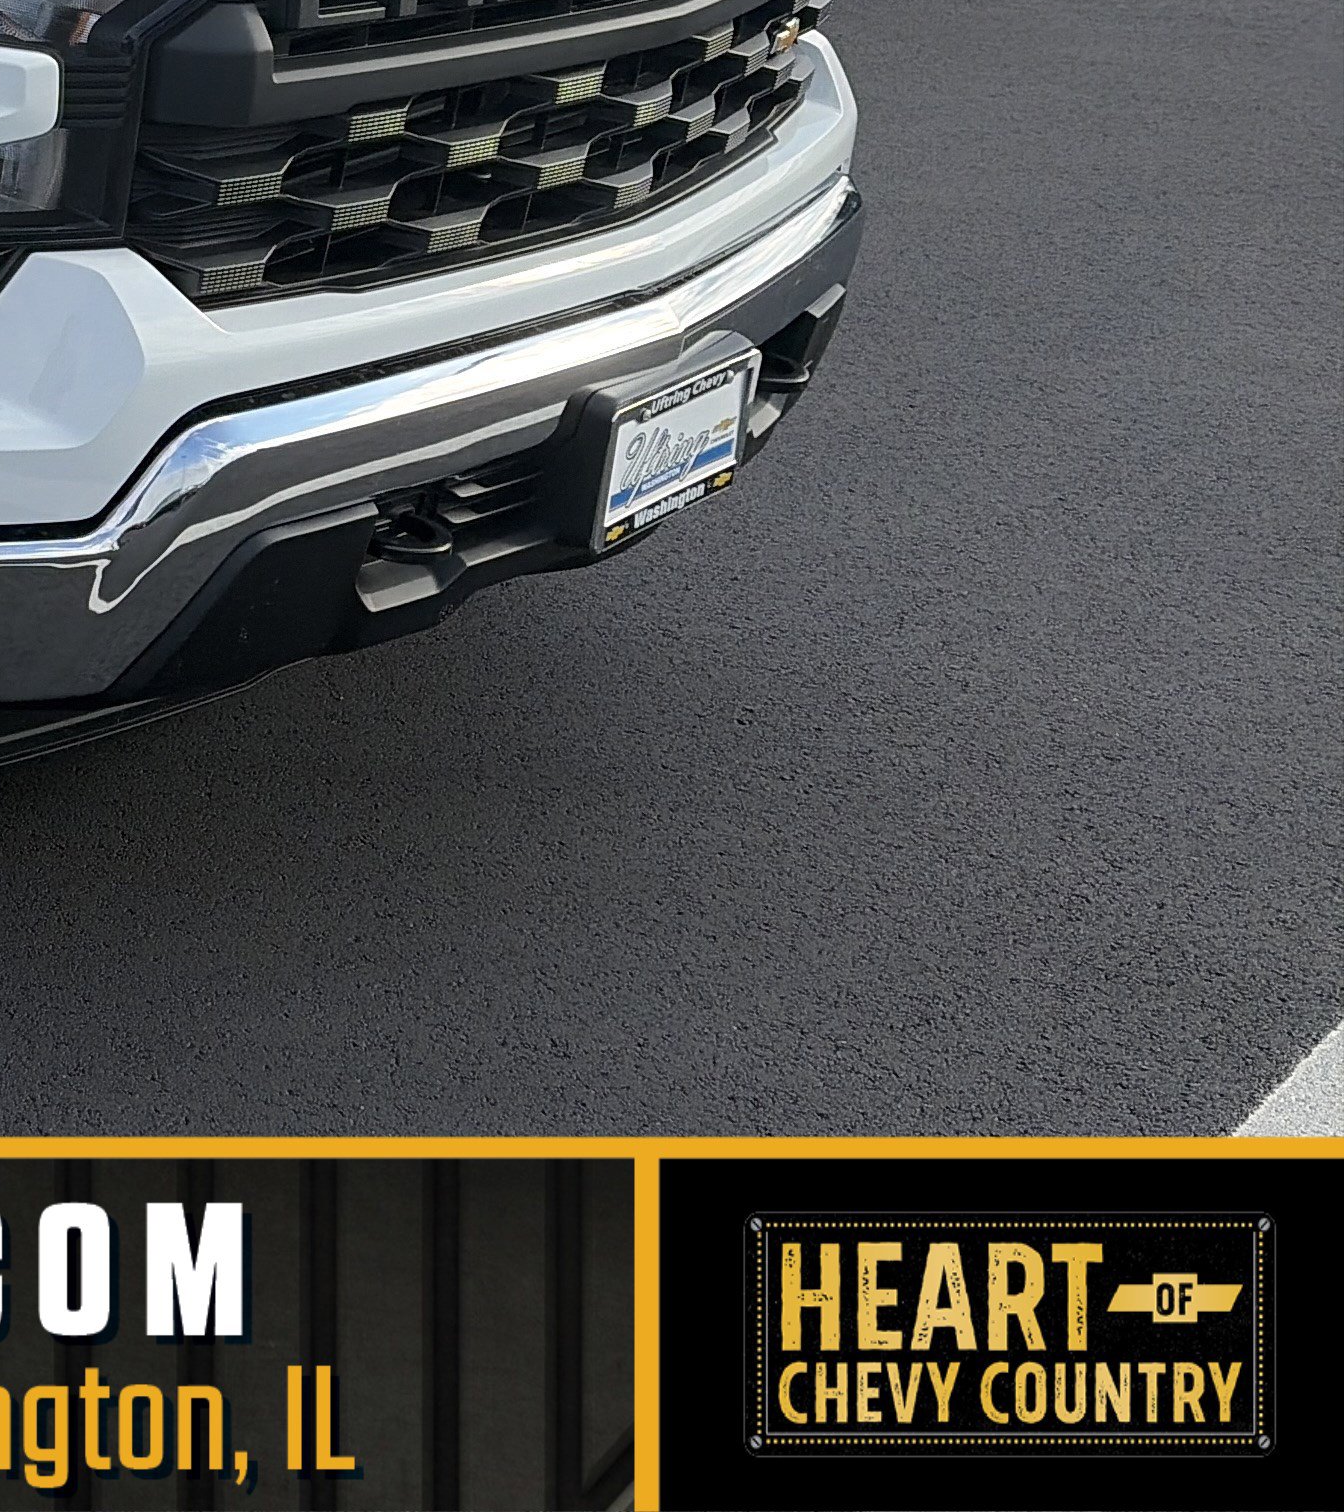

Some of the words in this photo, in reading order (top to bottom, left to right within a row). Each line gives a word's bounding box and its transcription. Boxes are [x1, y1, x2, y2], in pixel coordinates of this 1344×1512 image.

[651, 387, 692, 415] Uftring
[692, 372, 727, 396] Chevy
[620, 426, 710, 508] Uftring
[634, 483, 706, 529] Washington
